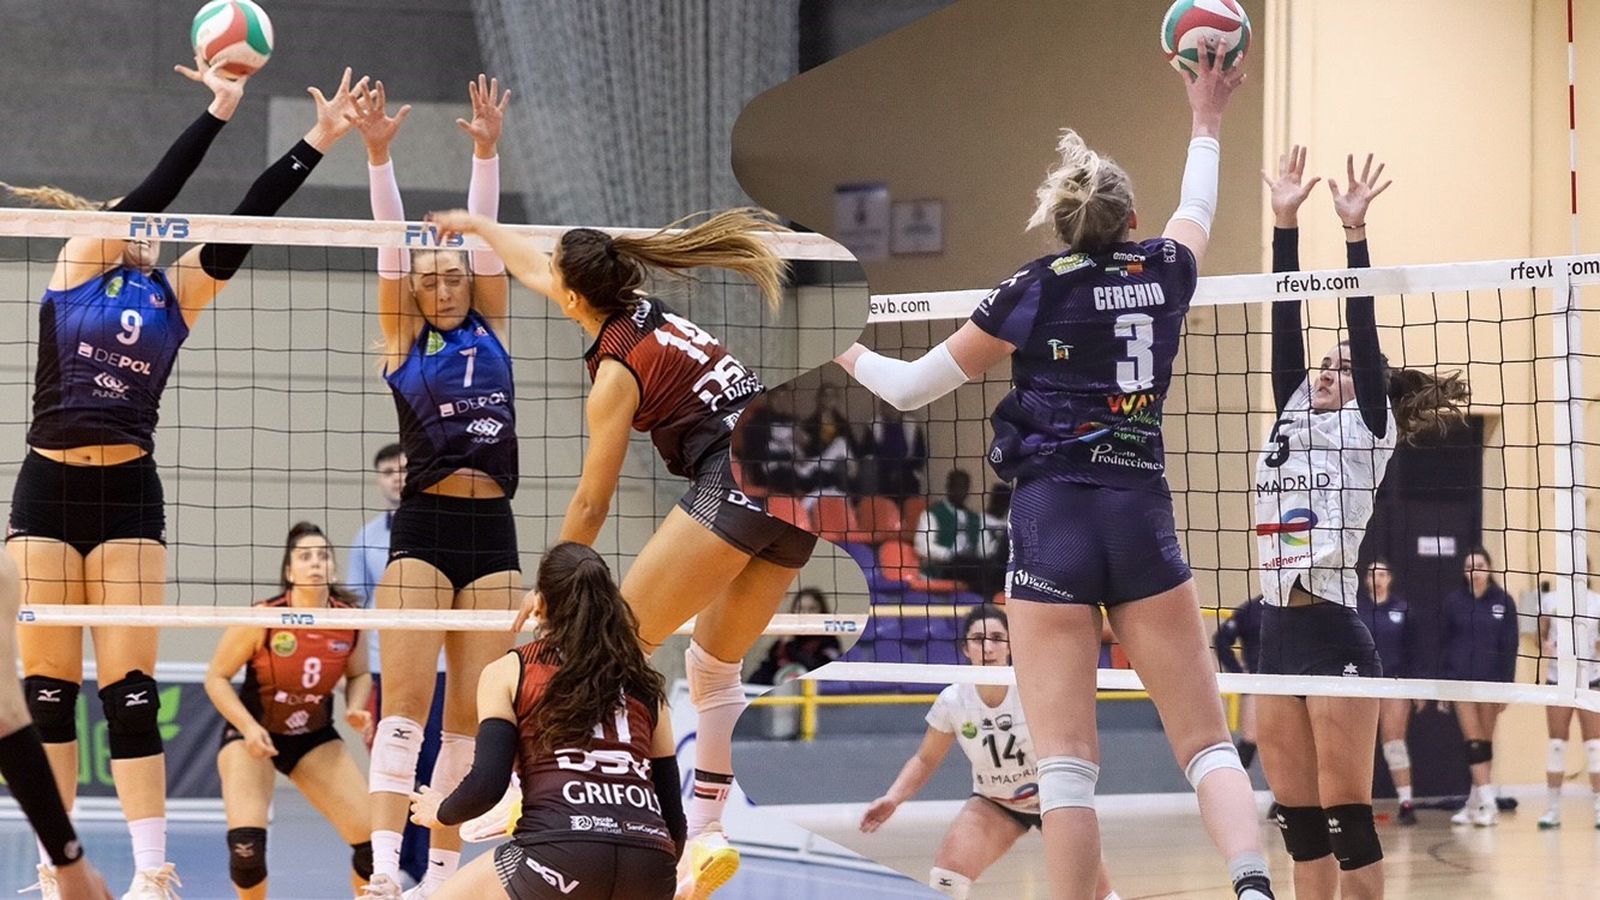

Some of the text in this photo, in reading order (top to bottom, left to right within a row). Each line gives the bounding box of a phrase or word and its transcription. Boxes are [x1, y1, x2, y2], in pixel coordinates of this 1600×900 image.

[129, 215, 190, 239] FIVB
[1093, 282, 1166, 311] CERCHIO
[1276, 274, 1360, 293] rfevb.com
[116, 309, 143, 346] 9
[94, 348, 152, 376] DEPOL
[459, 347, 478, 389] 7
[1114, 313, 1155, 393] 3
[692, 353, 748, 405] DS
[1090, 443, 1164, 470] Producciones
[1264, 419, 1295, 468] 5
[1256, 472, 1331, 498] MADRID
[281, 613, 315, 625] FIVB
[824, 620, 858, 632] FIVB
[302, 656, 322, 689] 8
[983, 733, 1026, 768] 14
[991, 767, 1039, 784] MADRI
[562, 780, 663, 816] GRIFOL
[526, 856, 580, 895] DSV
